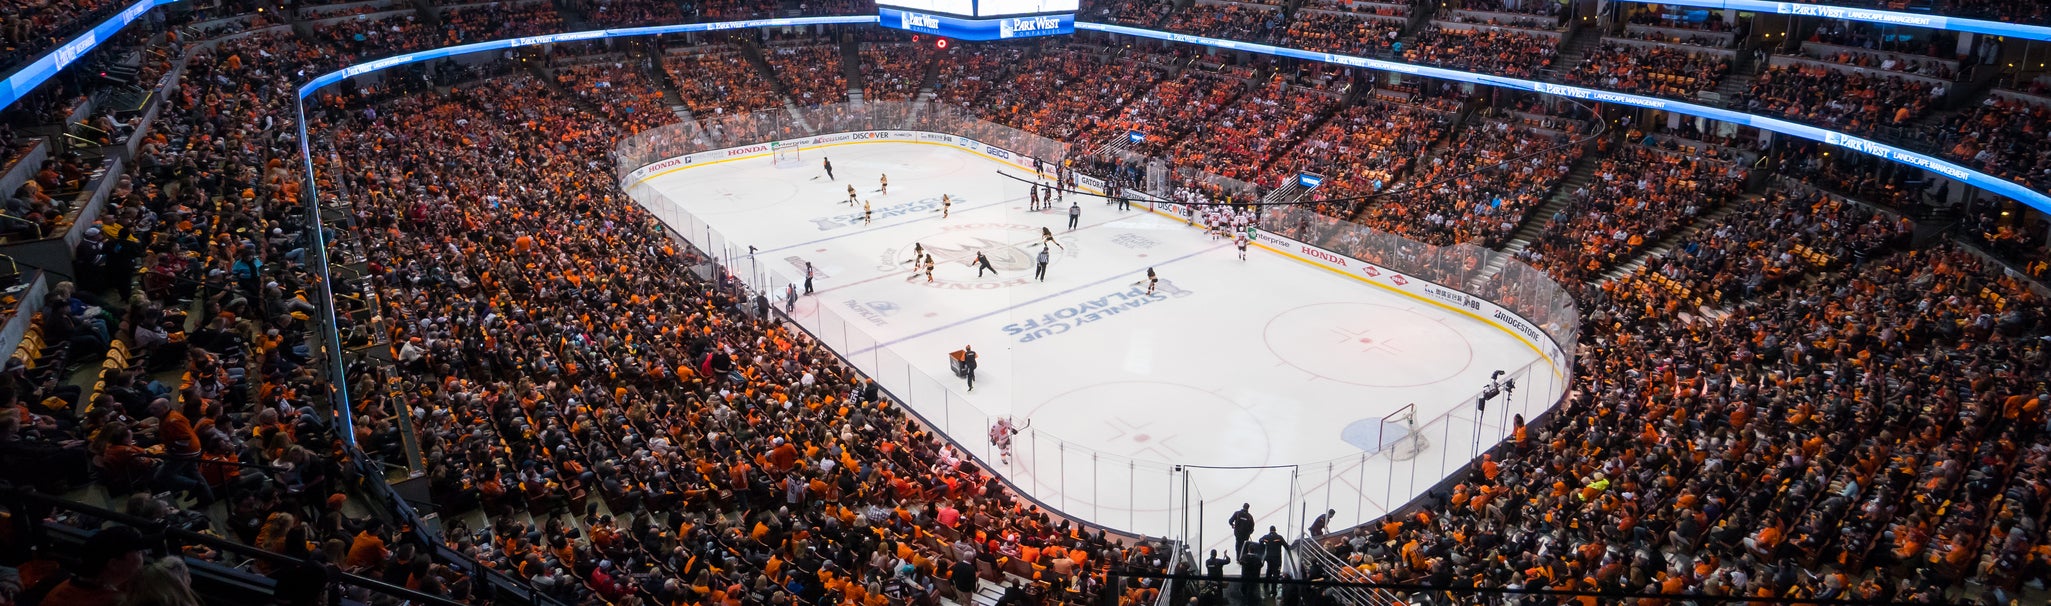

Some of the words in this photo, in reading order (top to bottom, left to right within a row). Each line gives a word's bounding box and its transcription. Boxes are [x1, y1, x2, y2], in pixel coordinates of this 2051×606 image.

[1013, 18, 1036, 32] PARK
[1036, 17, 1060, 30] WEST
[853, 131, 889, 139] DISCOVER
[728, 145, 768, 156] HONDA
[986, 146, 1009, 159] GEICO
[1840, 134, 1863, 151] PARK
[1863, 139, 1890, 158] WEST
[648, 159, 681, 173] HONDA
[1301, 246, 1347, 267] HONDA
[1001, 287, 1147, 336] PLAYOFFS
[1076, 291, 1167, 327] STANLEY
[1019, 321, 1071, 343] CUP
[1494, 309, 1540, 342] BRIDGESTONE
